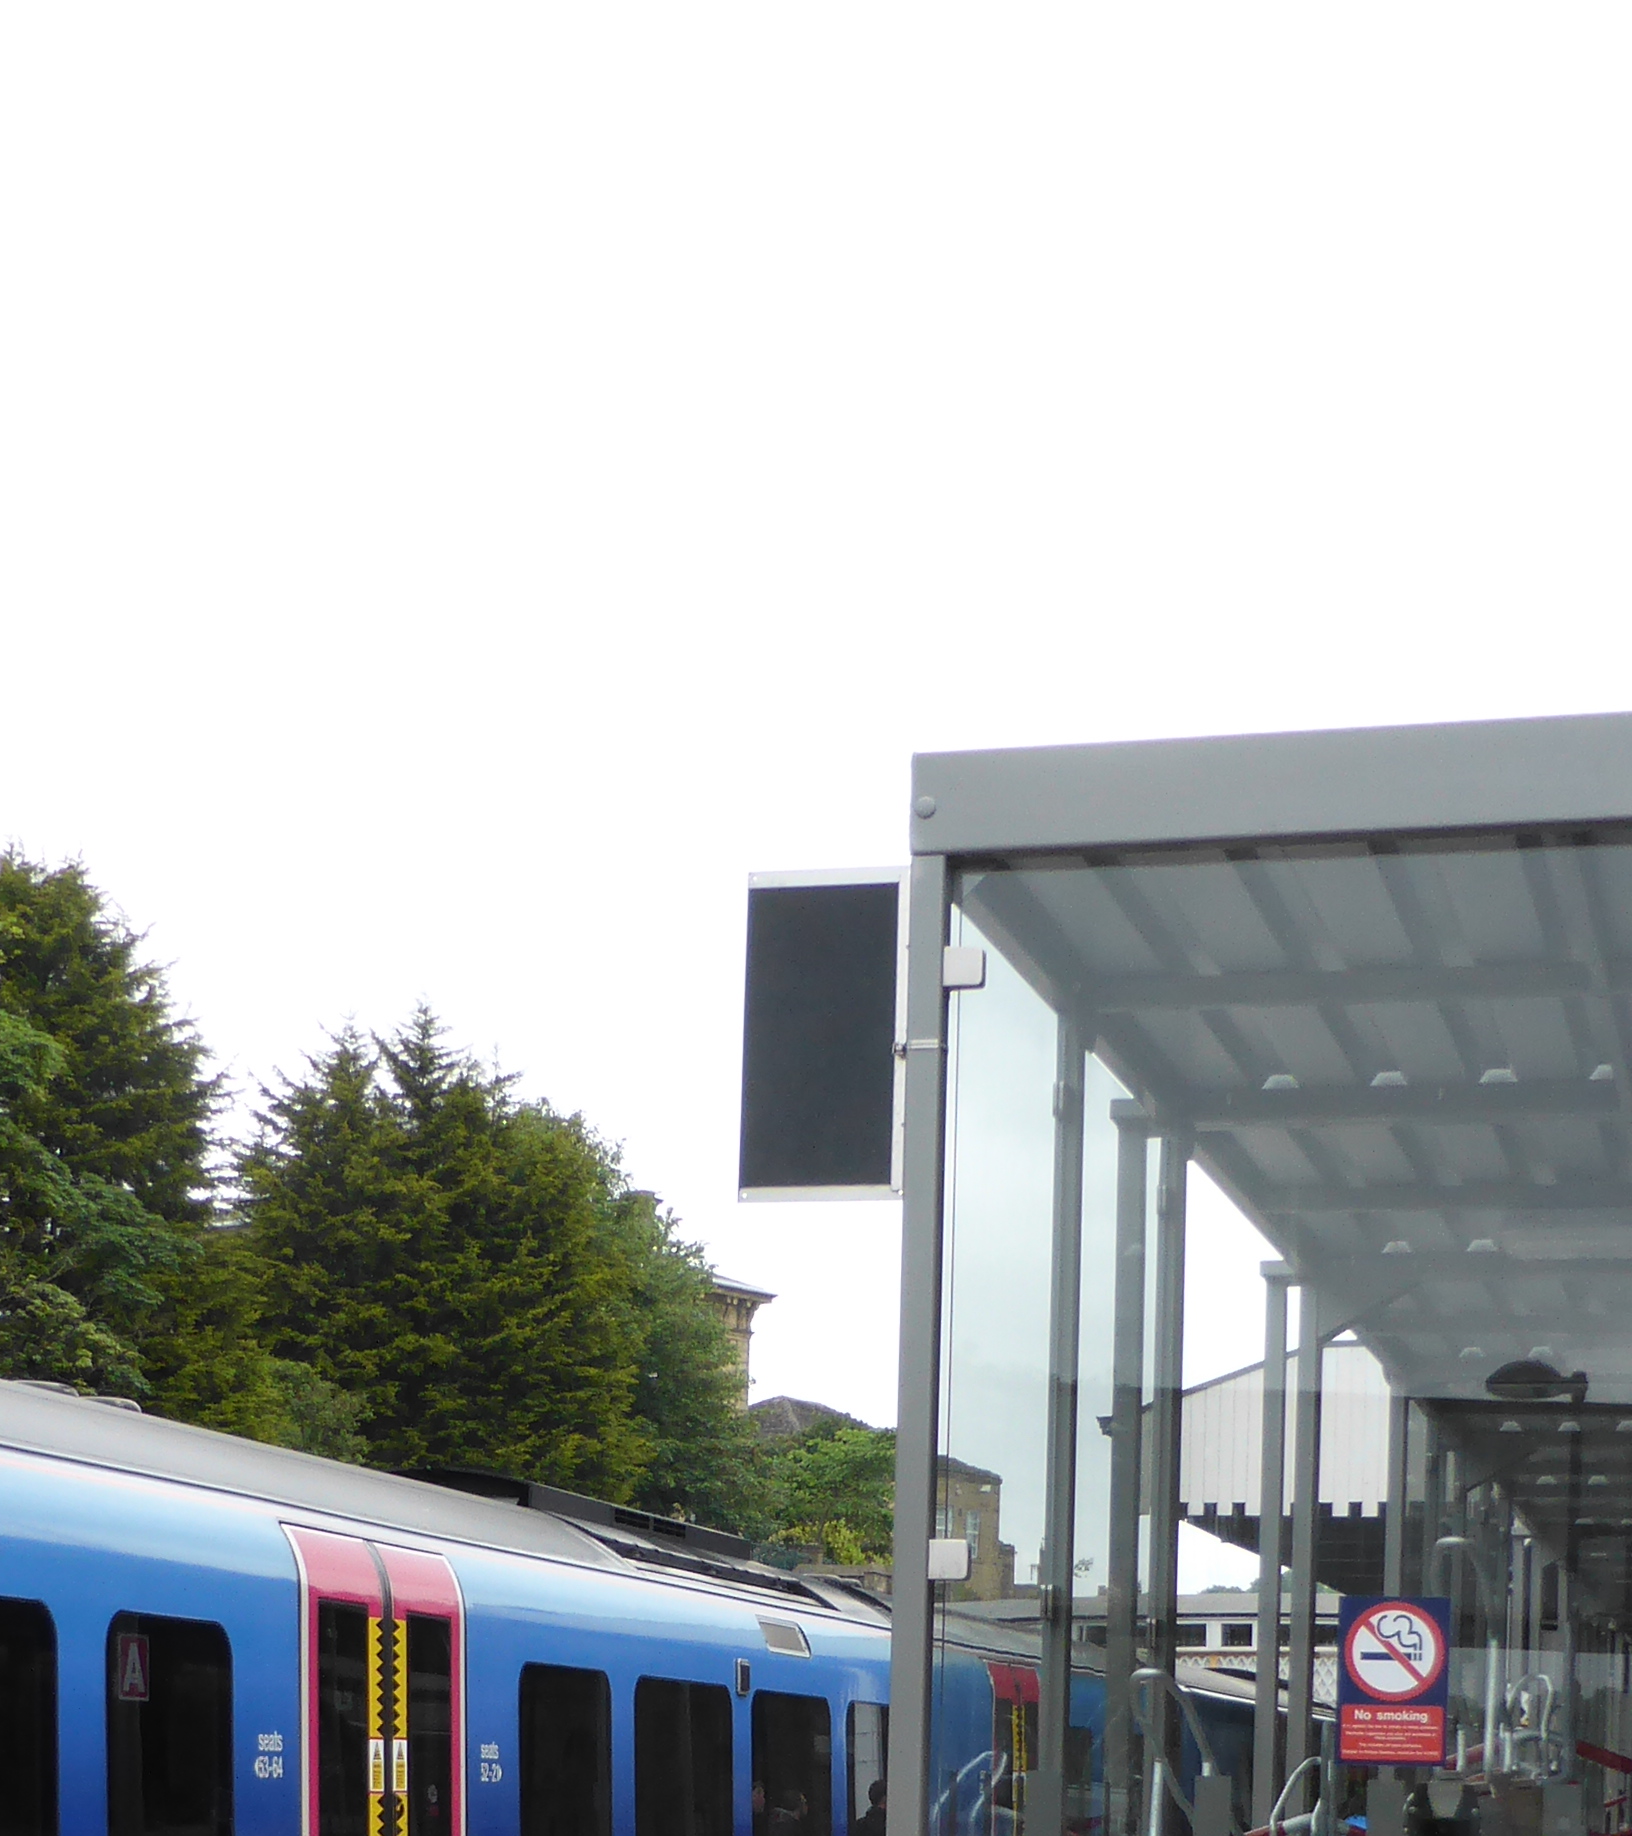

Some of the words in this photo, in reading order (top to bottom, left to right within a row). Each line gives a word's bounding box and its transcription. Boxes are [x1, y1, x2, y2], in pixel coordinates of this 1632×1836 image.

[123, 1642, 146, 1693] A
[1353, 1708, 1372, 1721] No
[1376, 1710, 1429, 1724] smoking
[257, 1730, 284, 1752] seats
[480, 1741, 500, 1760] seats
